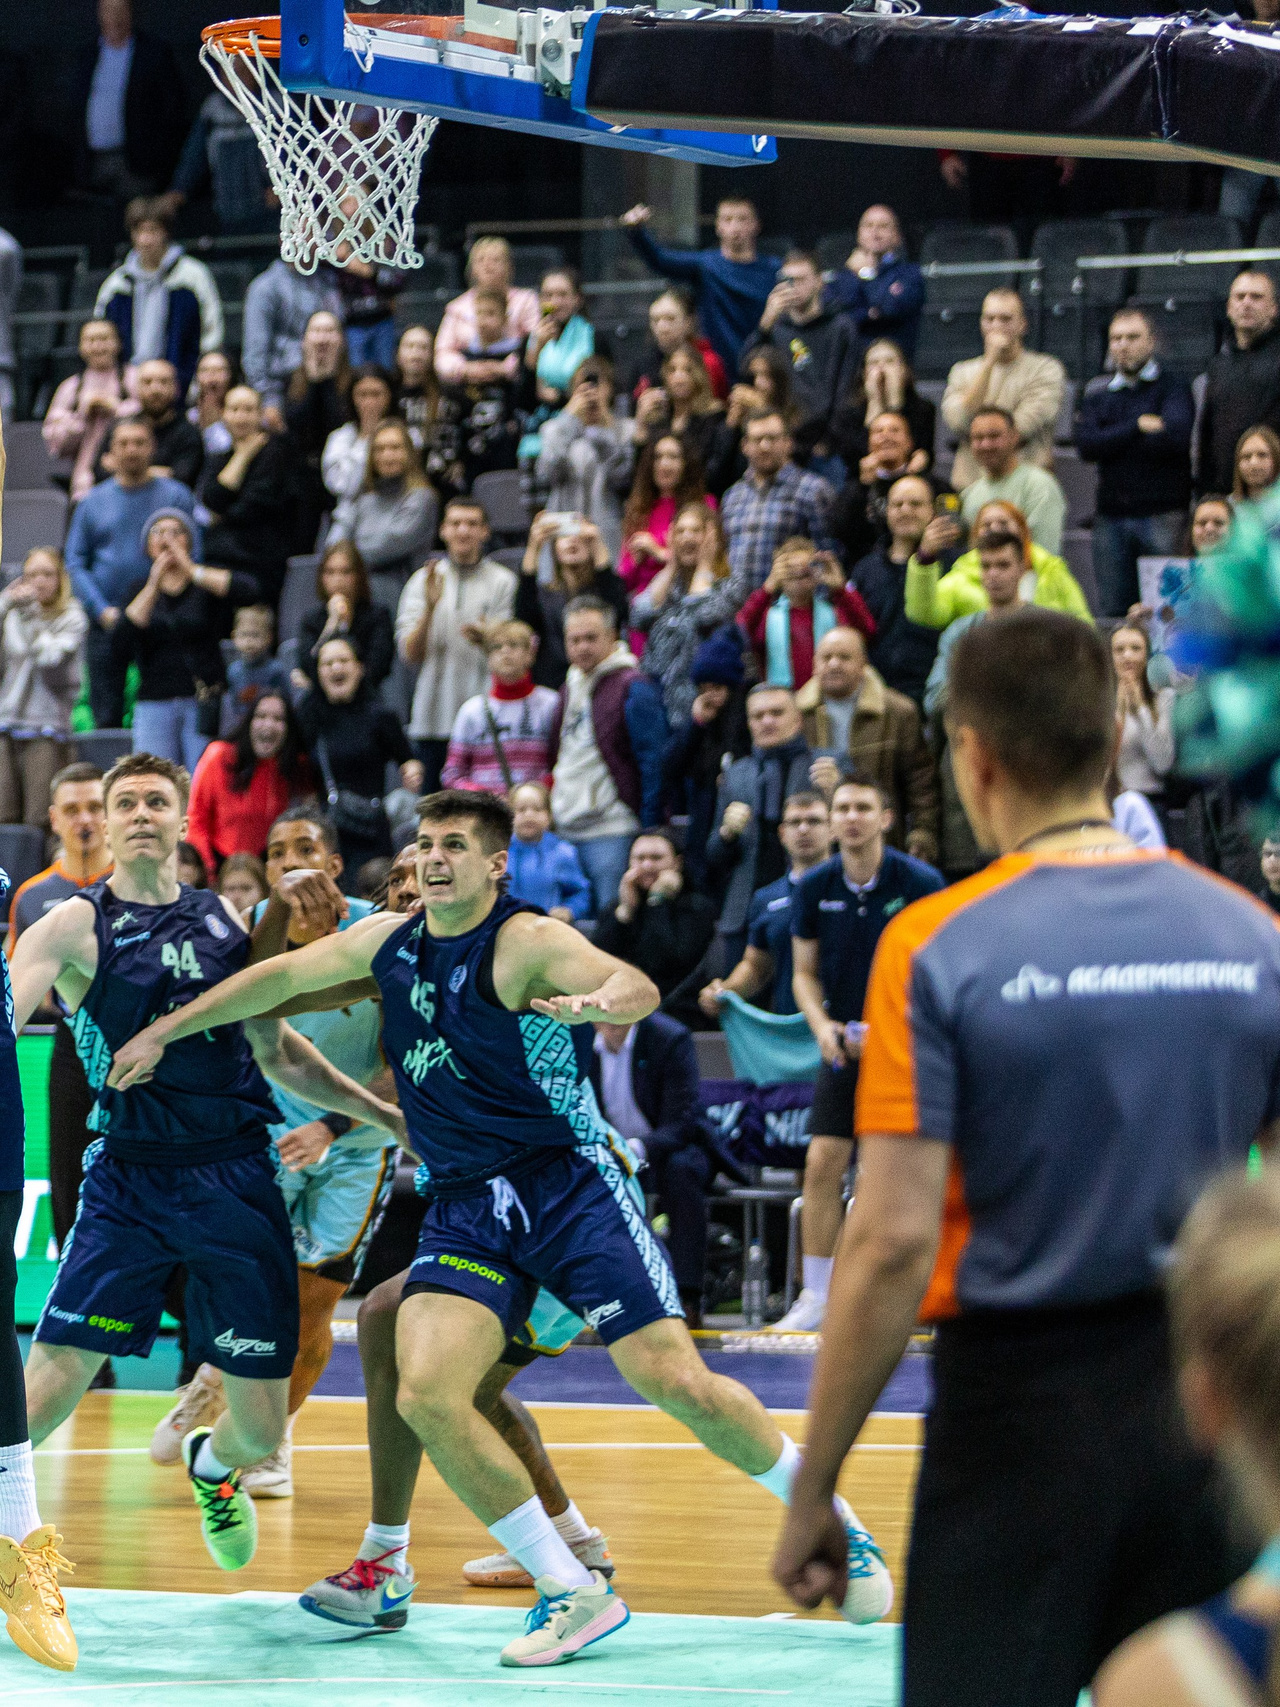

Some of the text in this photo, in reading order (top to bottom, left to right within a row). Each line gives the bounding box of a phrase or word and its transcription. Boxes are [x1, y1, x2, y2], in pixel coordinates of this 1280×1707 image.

[161, 940, 204, 979] 44
[1066, 959, 1261, 996] ACADEMSERVICE
[438, 1253, 507, 1285] евроопт
